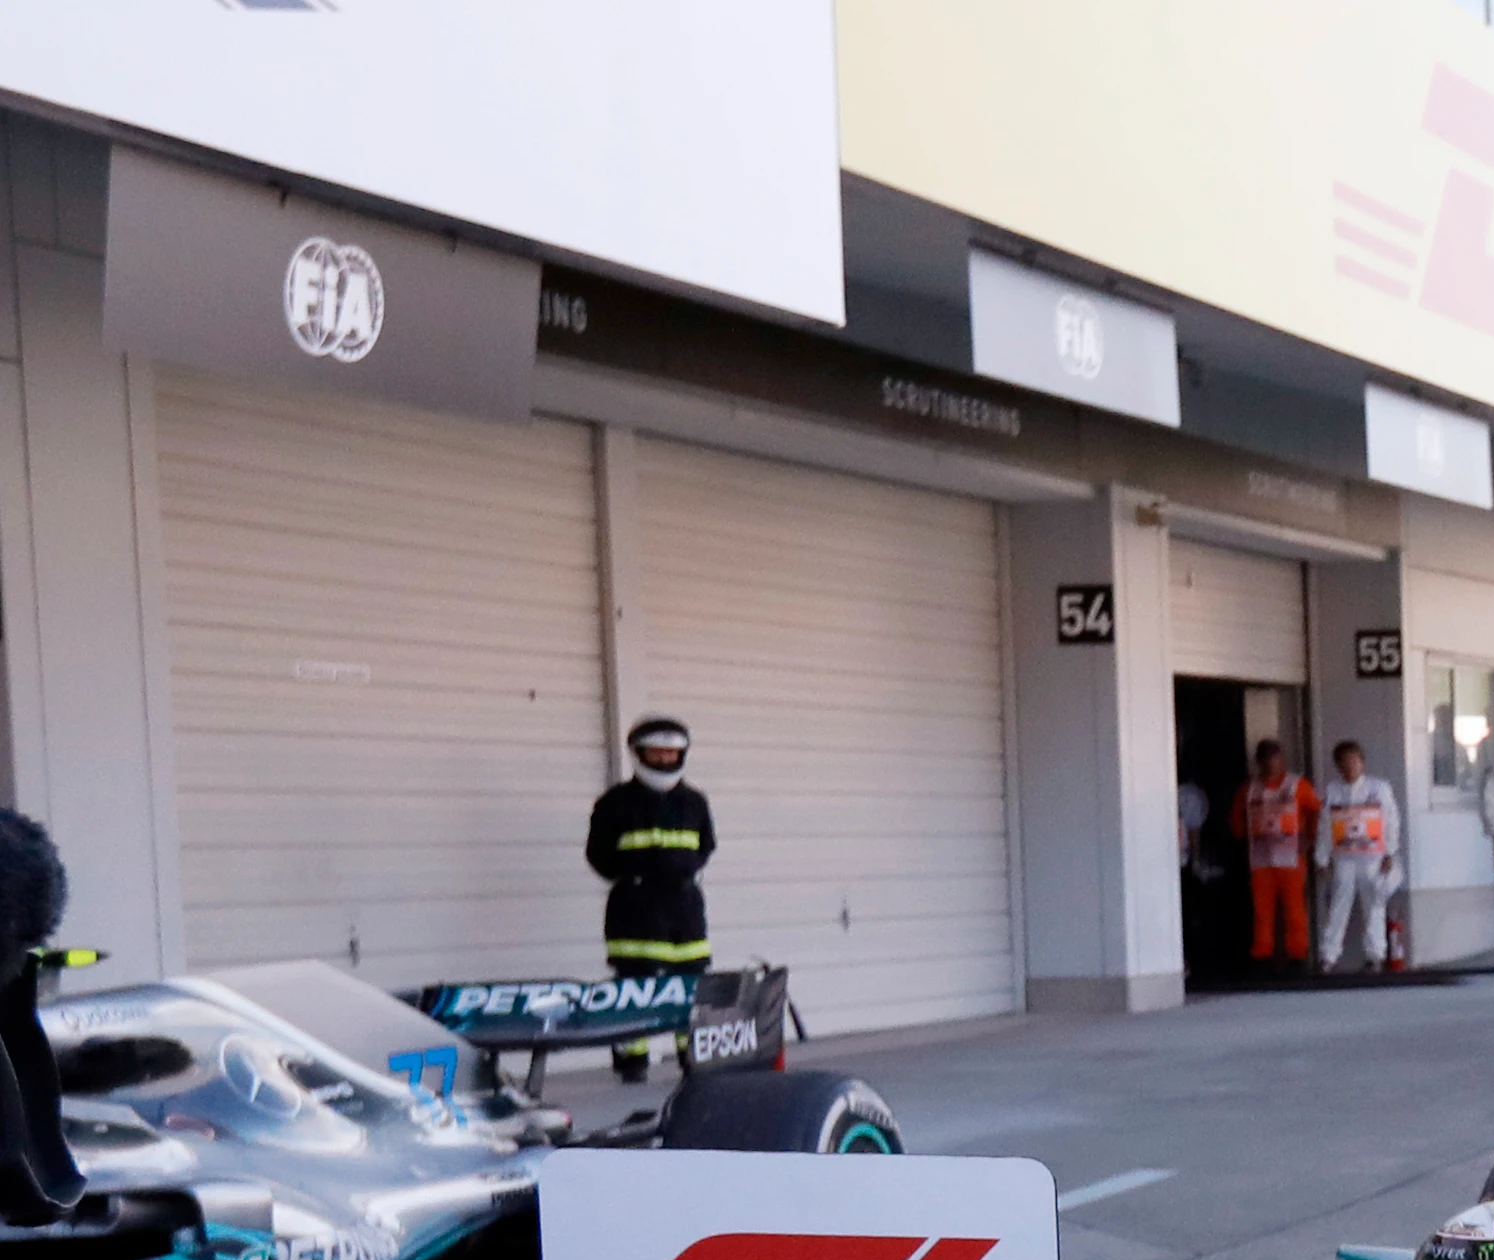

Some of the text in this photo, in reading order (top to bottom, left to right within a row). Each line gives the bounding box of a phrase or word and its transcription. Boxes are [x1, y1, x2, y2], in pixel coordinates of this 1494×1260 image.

[1059, 590, 1113, 638] 54
[1357, 635, 1400, 674] 55
[694, 1017, 758, 1062] EPSON
